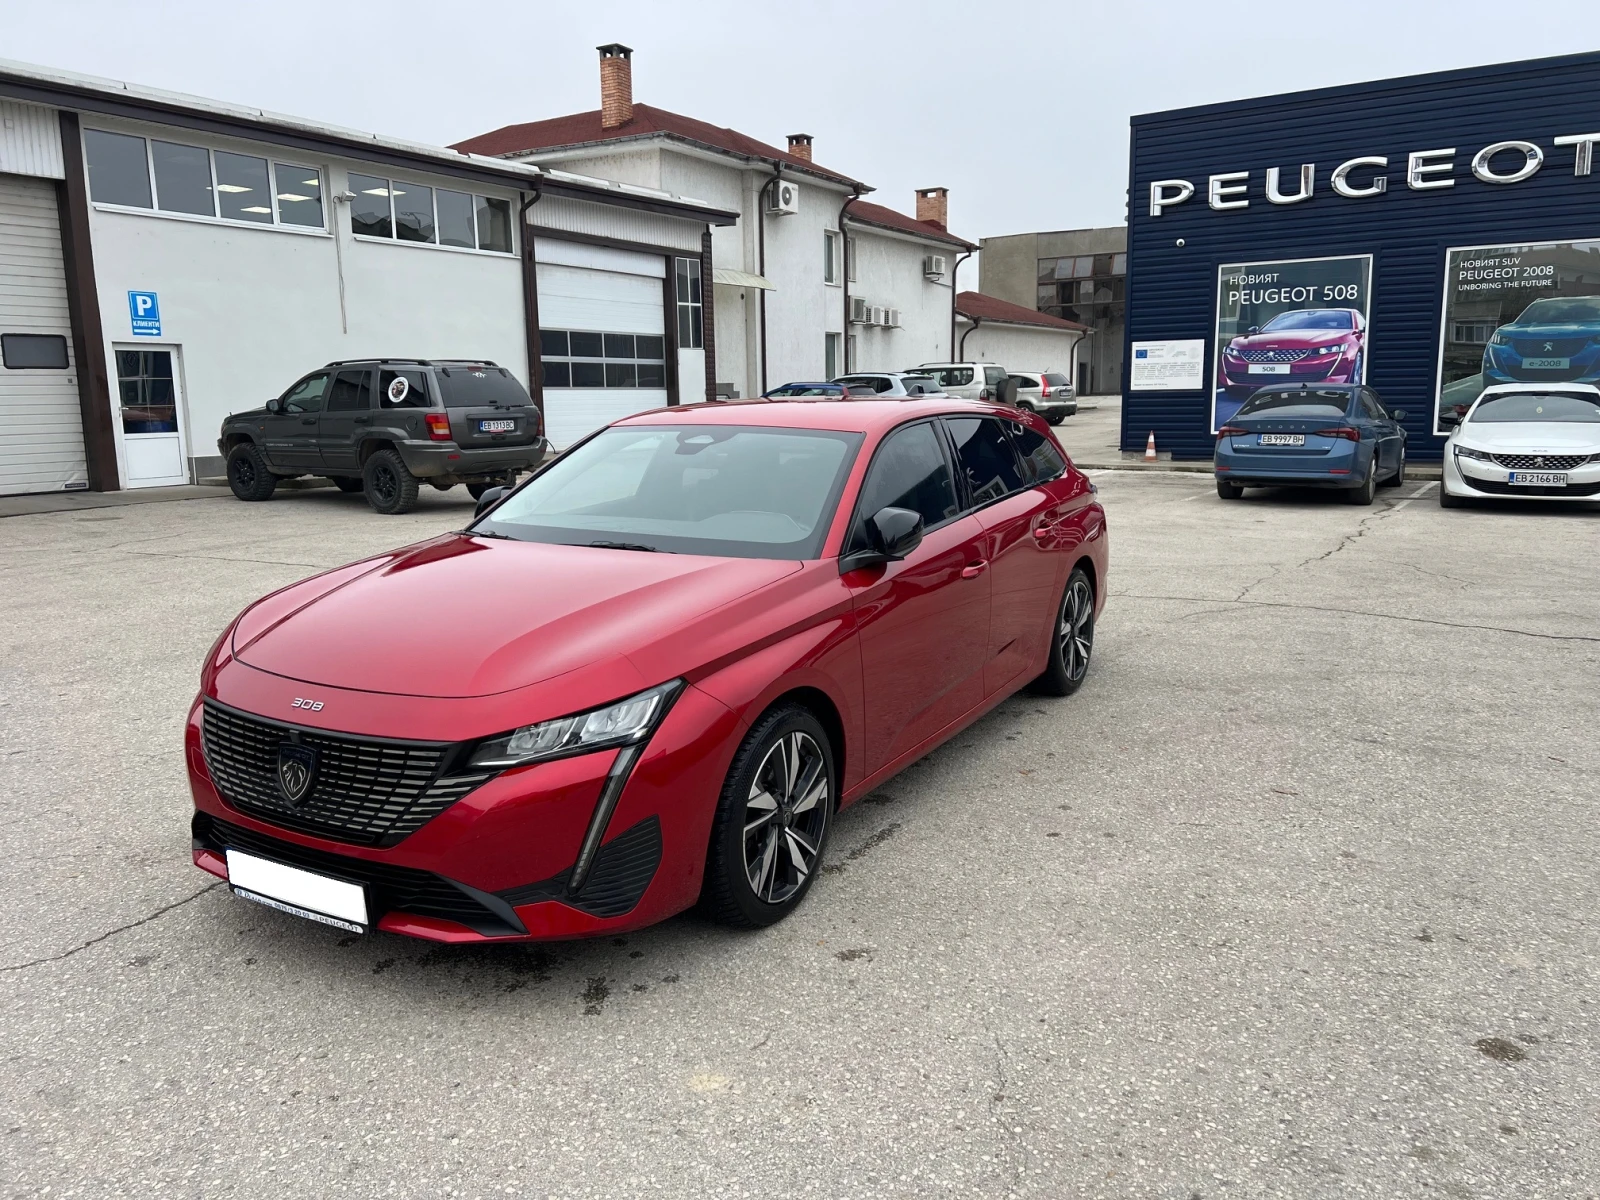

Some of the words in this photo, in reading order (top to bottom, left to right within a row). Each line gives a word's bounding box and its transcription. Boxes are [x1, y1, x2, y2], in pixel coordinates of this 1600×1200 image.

[1149, 132, 1600, 217] PEUGEOT
[1460, 259, 1500, 268] НОВИЯТ
[1502, 257, 1521, 266] SUV
[1459, 267, 1520, 280] PEUGEOT
[1523, 265, 1554, 277] 2008
[1229, 273, 1279, 285] НОВИЯТ
[1458, 281, 1501, 291] UNBORING
[1521, 279, 1552, 287] FUTURE
[1229, 286, 1318, 305] PEUGEOT
[1323, 284, 1358, 301] 508
[136, 295, 152, 316] P
[1529, 359, 1561, 367] e-2008
[1274, 435, 1291, 443] 9997
[1293, 435, 1304, 443] BH
[1515, 474, 1527, 483] EB
[1529, 474, 1551, 483] 2166
[1552, 475, 1565, 483] BH
[291, 697, 325, 711] 308
